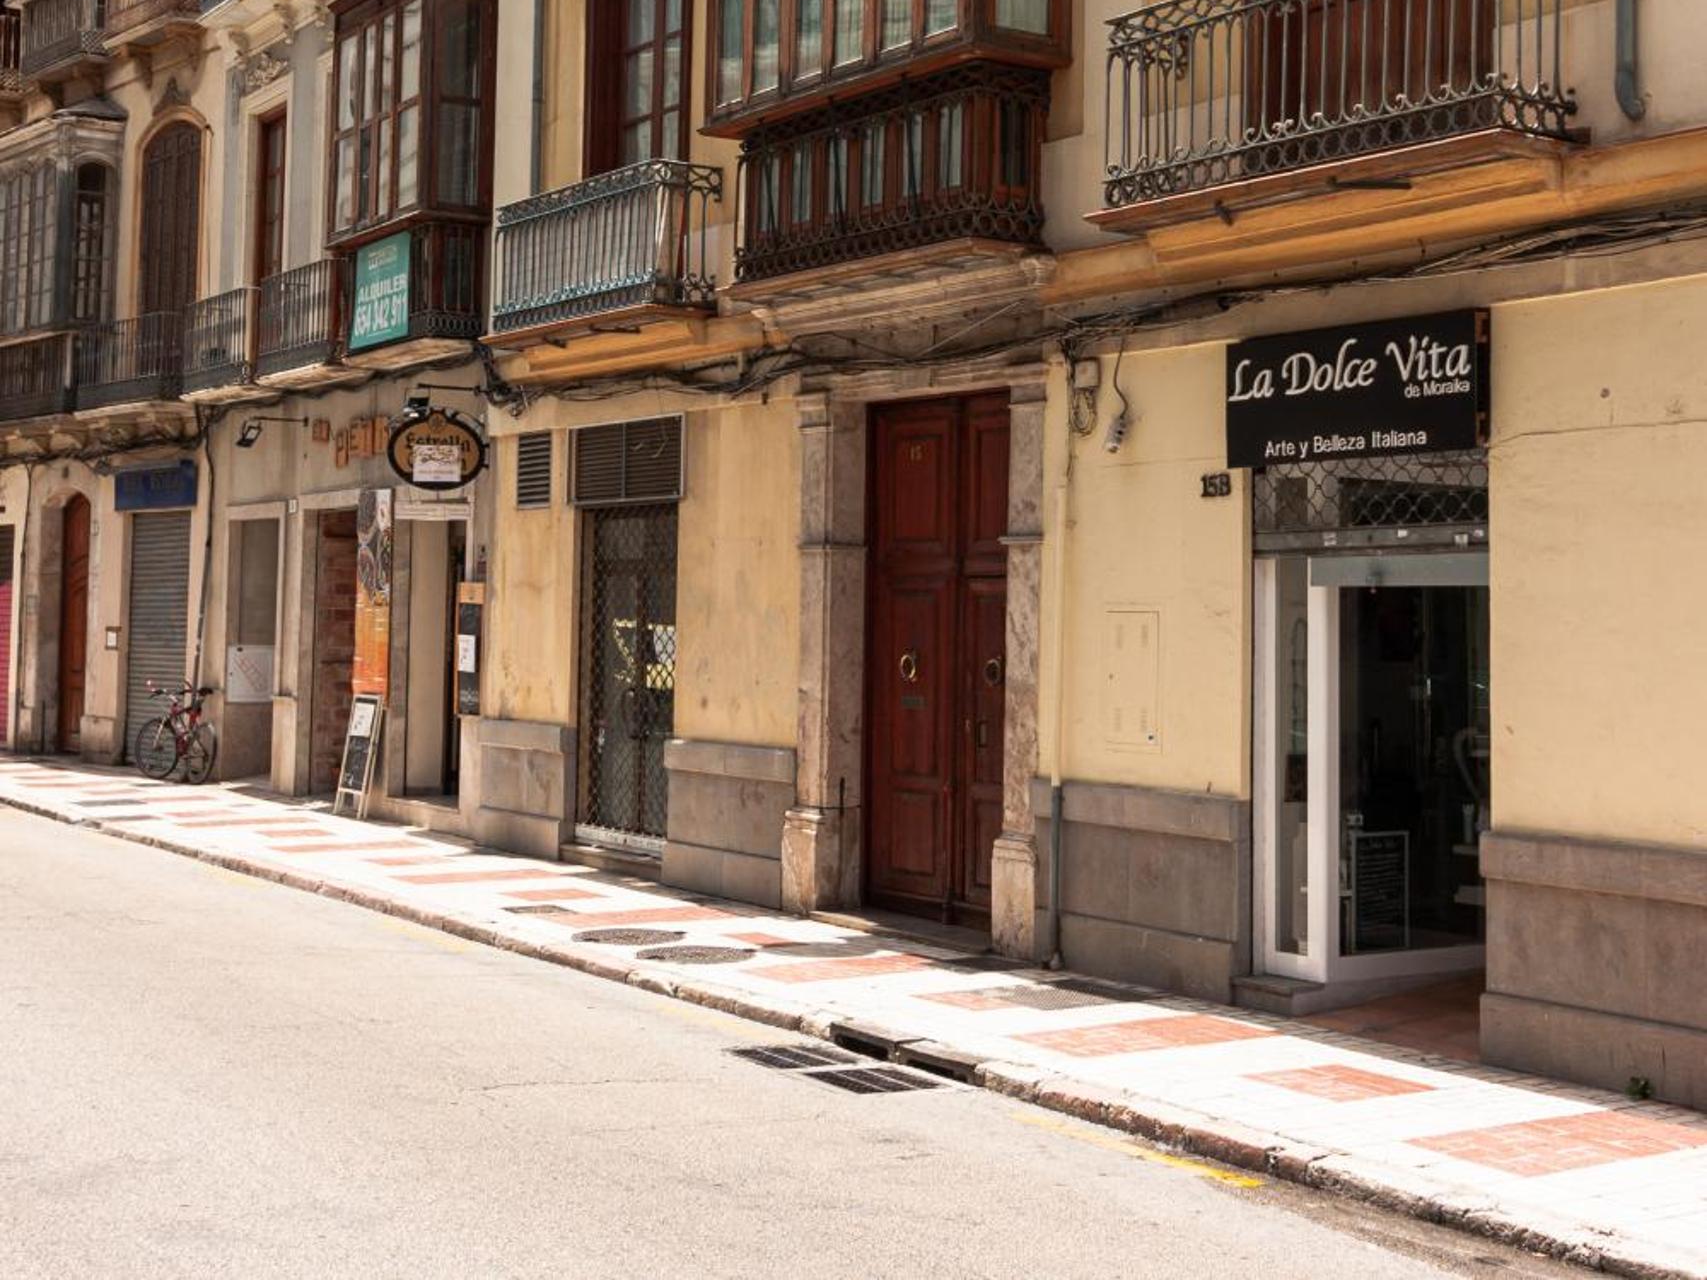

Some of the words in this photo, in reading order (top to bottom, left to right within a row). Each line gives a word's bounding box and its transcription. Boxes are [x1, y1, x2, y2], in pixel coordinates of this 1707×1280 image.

[358, 273, 407, 304] ALQUILER
[1228, 359, 1274, 402] La
[1281, 338, 1378, 395] Dolce
[1385, 335, 1471, 382] Vita
[1404, 383, 1420, 398] de
[1423, 378, 1470, 397] Moraika
[1264, 440, 1296, 458] Arte
[1299, 441, 1308, 458] y
[1313, 434, 1366, 453] Belleza
[1371, 430, 1427, 448] Italiana
